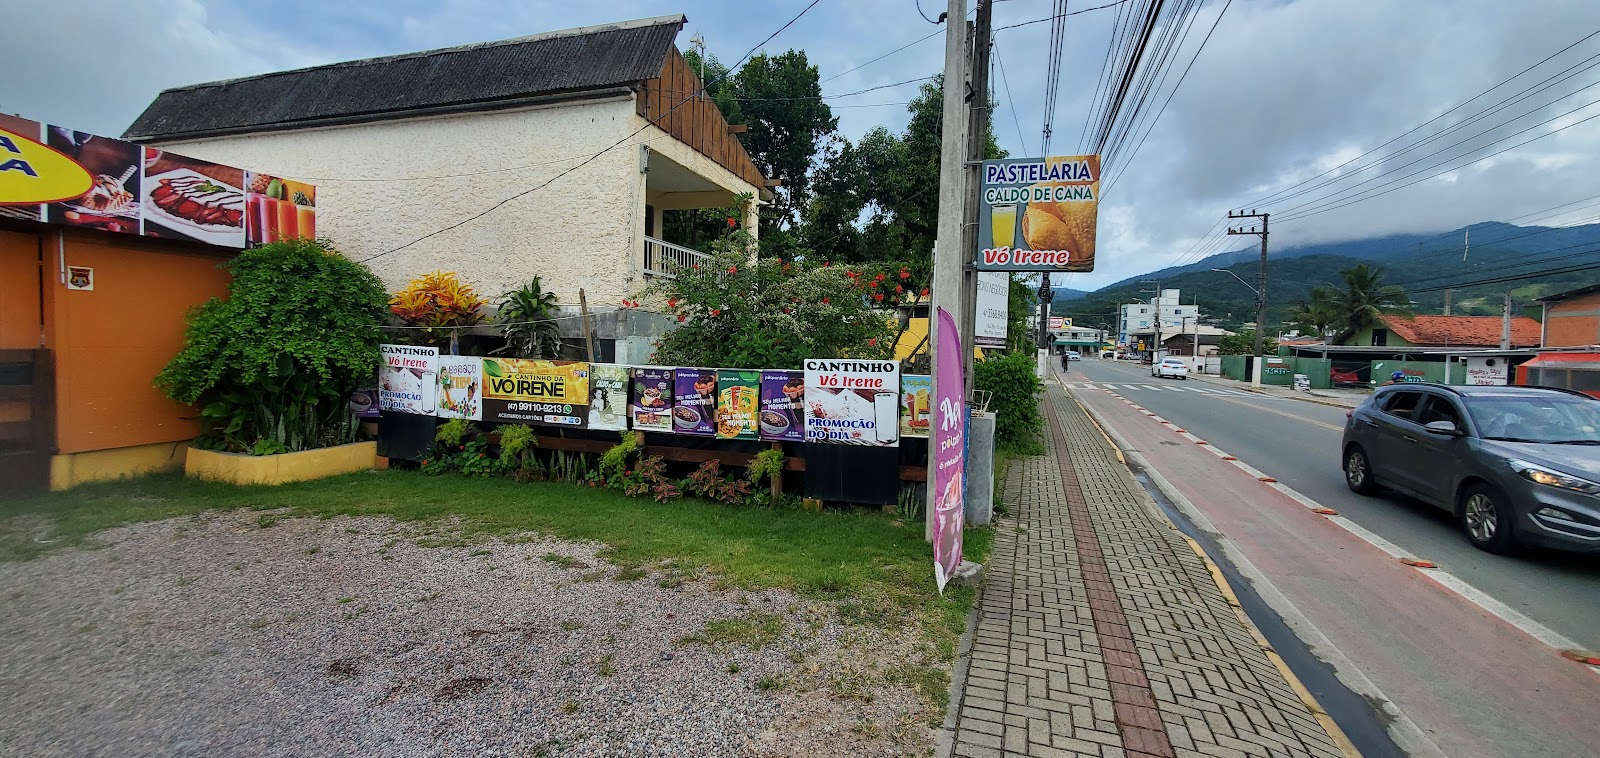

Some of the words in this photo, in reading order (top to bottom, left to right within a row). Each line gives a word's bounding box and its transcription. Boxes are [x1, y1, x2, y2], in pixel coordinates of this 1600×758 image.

[987, 161, 1091, 183] PASTELARIA
[986, 187, 1030, 203] CALDO
[1034, 188, 1050, 201] DE
[1055, 186, 1093, 200] CANA
[984, 248, 1008, 264] Vó
[1014, 250, 1069, 264] Irene
[381, 346, 435, 356] CANTINHO
[388, 356, 400, 366] Vó
[402, 357, 428, 368] Irene
[806, 362, 894, 372] CANTINHO
[492, 375, 515, 394] VÓ
[517, 380, 564, 397] IRENE
[820, 374, 838, 386] Vó
[843, 376, 883, 388] Irene
[380, 390, 422, 400] PROMOÇÃO
[508, 402, 518, 411] (47)
[518, 402, 562, 413] 99110-9213
[808, 418, 874, 429] PROMOÇÃO
[808, 430, 826, 439] DO
[830, 431, 850, 440] DIA
